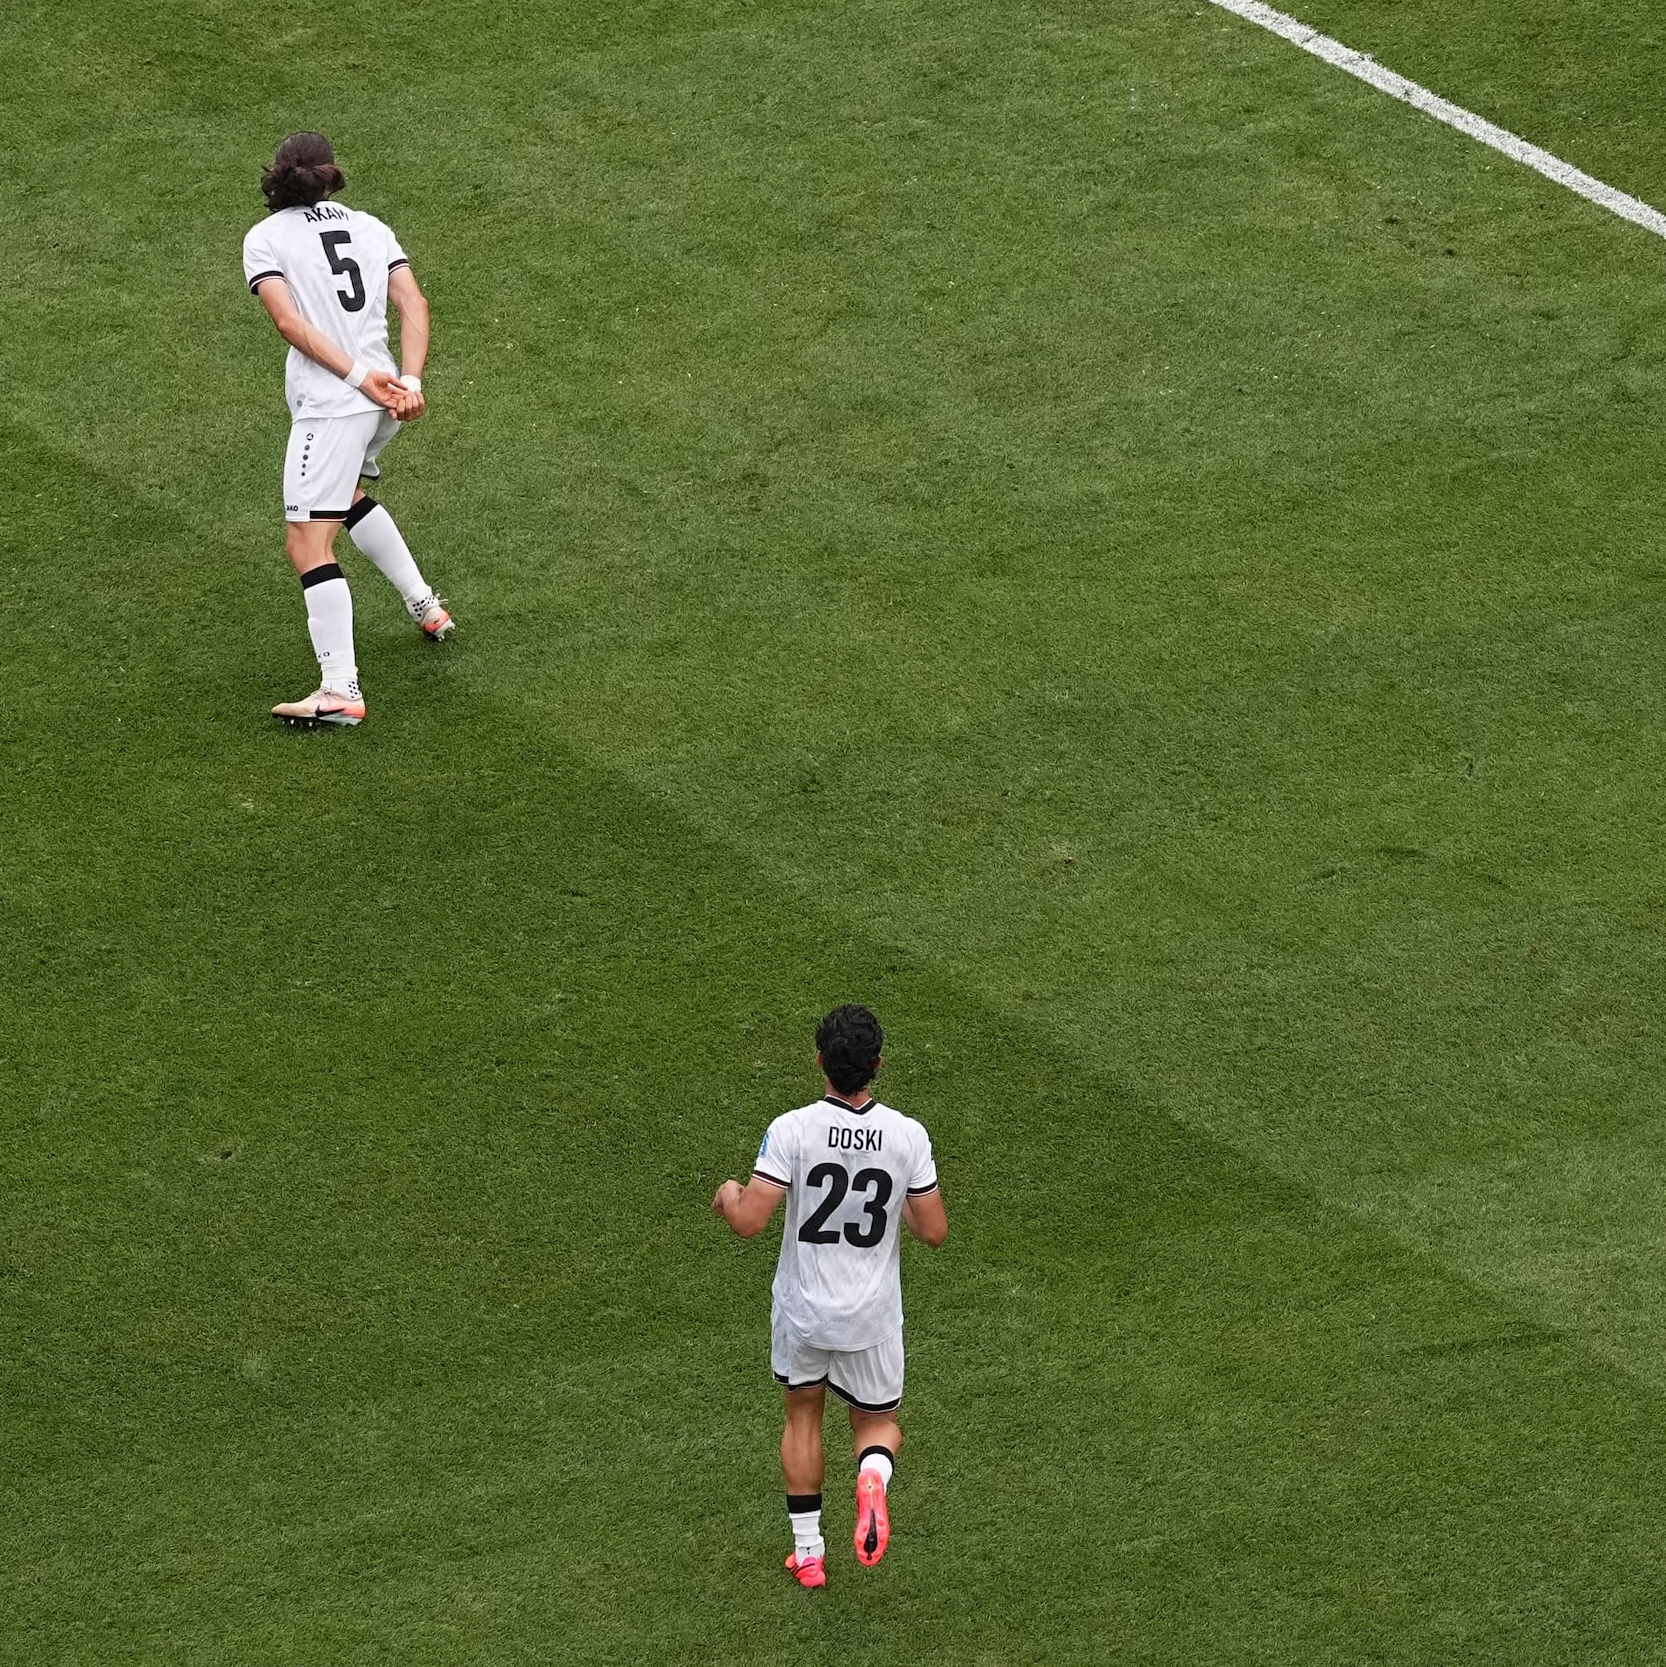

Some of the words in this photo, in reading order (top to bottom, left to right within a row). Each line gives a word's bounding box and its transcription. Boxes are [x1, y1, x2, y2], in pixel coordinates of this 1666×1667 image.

[319, 230, 366, 312] 5
[827, 1125, 883, 1152] DOSKI
[797, 1162, 893, 1248] 23
